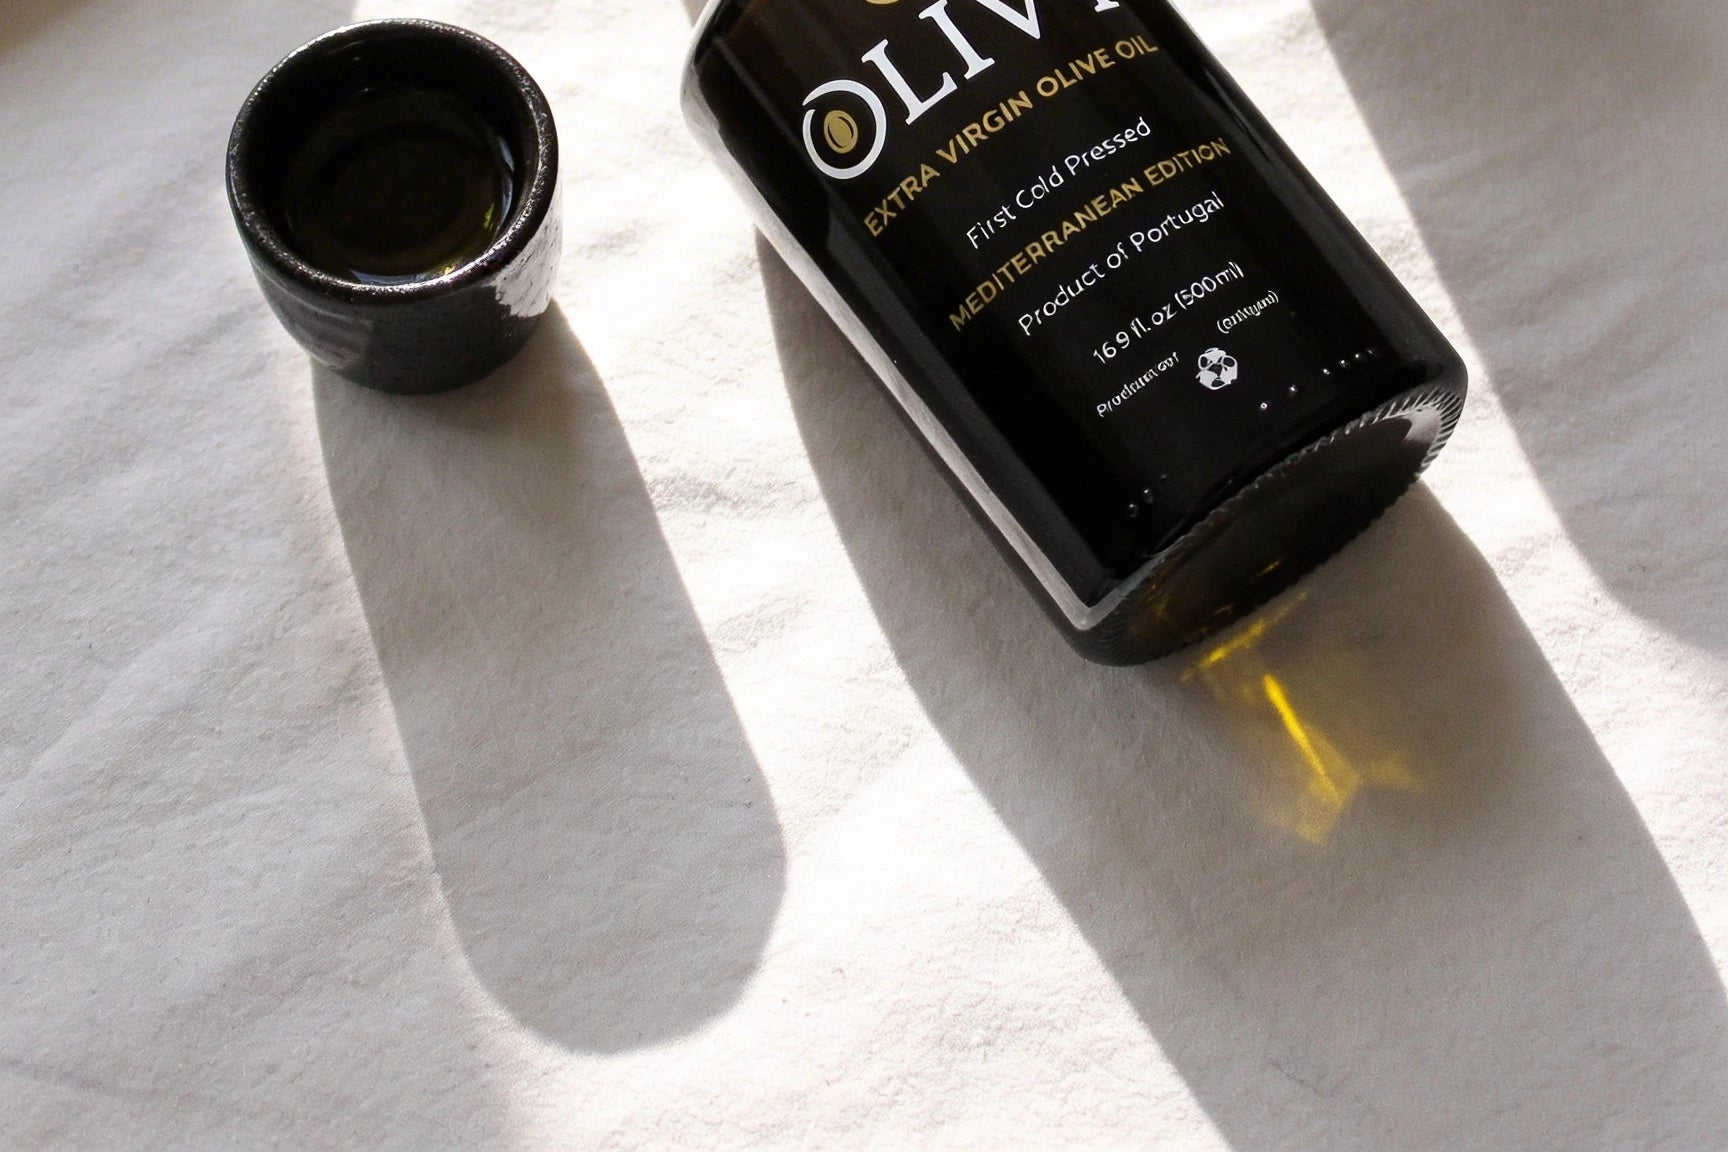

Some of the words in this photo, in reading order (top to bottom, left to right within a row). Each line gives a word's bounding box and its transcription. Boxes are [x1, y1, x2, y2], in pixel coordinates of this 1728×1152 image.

[863, 163, 940, 237] EXTRA
[936, 90, 1033, 165] VIRGIN
[1036, 48, 1116, 97] OLIVE
[1115, 35, 1158, 60] OIL
[966, 204, 1017, 249] First
[1016, 165, 1064, 209] Cold
[1064, 116, 1151, 176] Pressed
[949, 177, 1144, 332] MEDITERRANEAN
[1143, 137, 1232, 186] EDITION
[1018, 263, 1106, 336] Product
[1106, 242, 1129, 269] of
[1129, 191, 1225, 252] Portugal
[1151, 303, 1178, 326] oz
